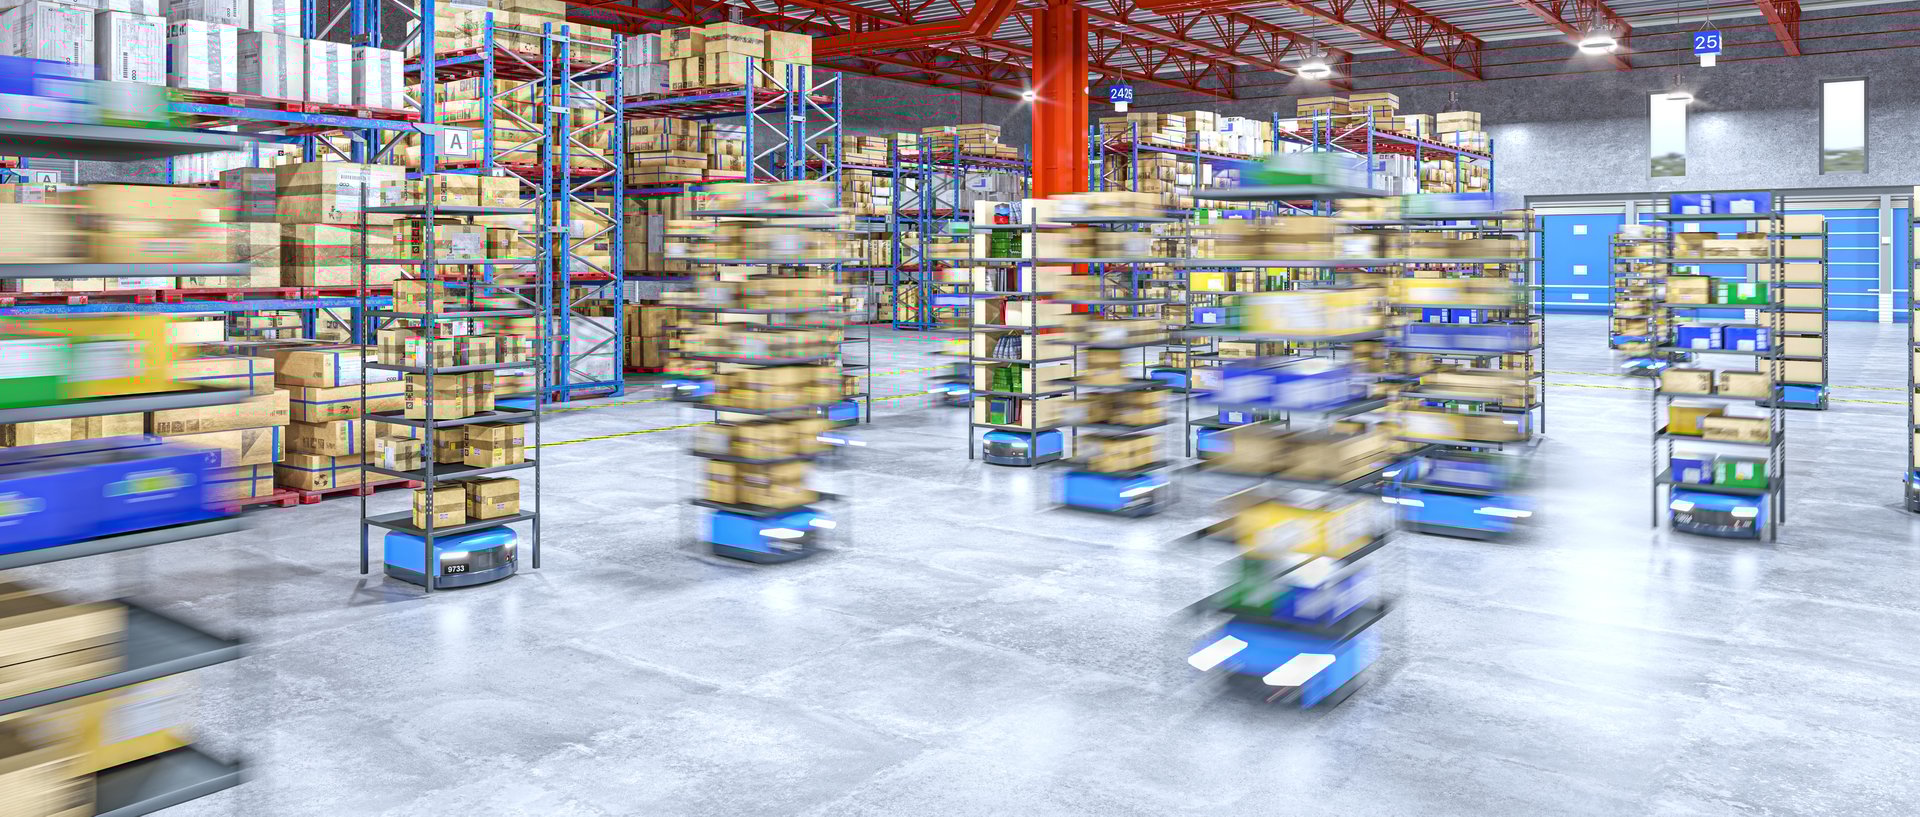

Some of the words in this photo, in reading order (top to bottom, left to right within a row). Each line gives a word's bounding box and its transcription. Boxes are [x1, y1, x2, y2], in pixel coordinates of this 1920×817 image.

[1695, 35, 1718, 50] 25
[1110, 88, 1124, 99] 24
[450, 133, 462, 150] A
[43, 174, 51, 183] A
[447, 565, 465, 573] 9733
